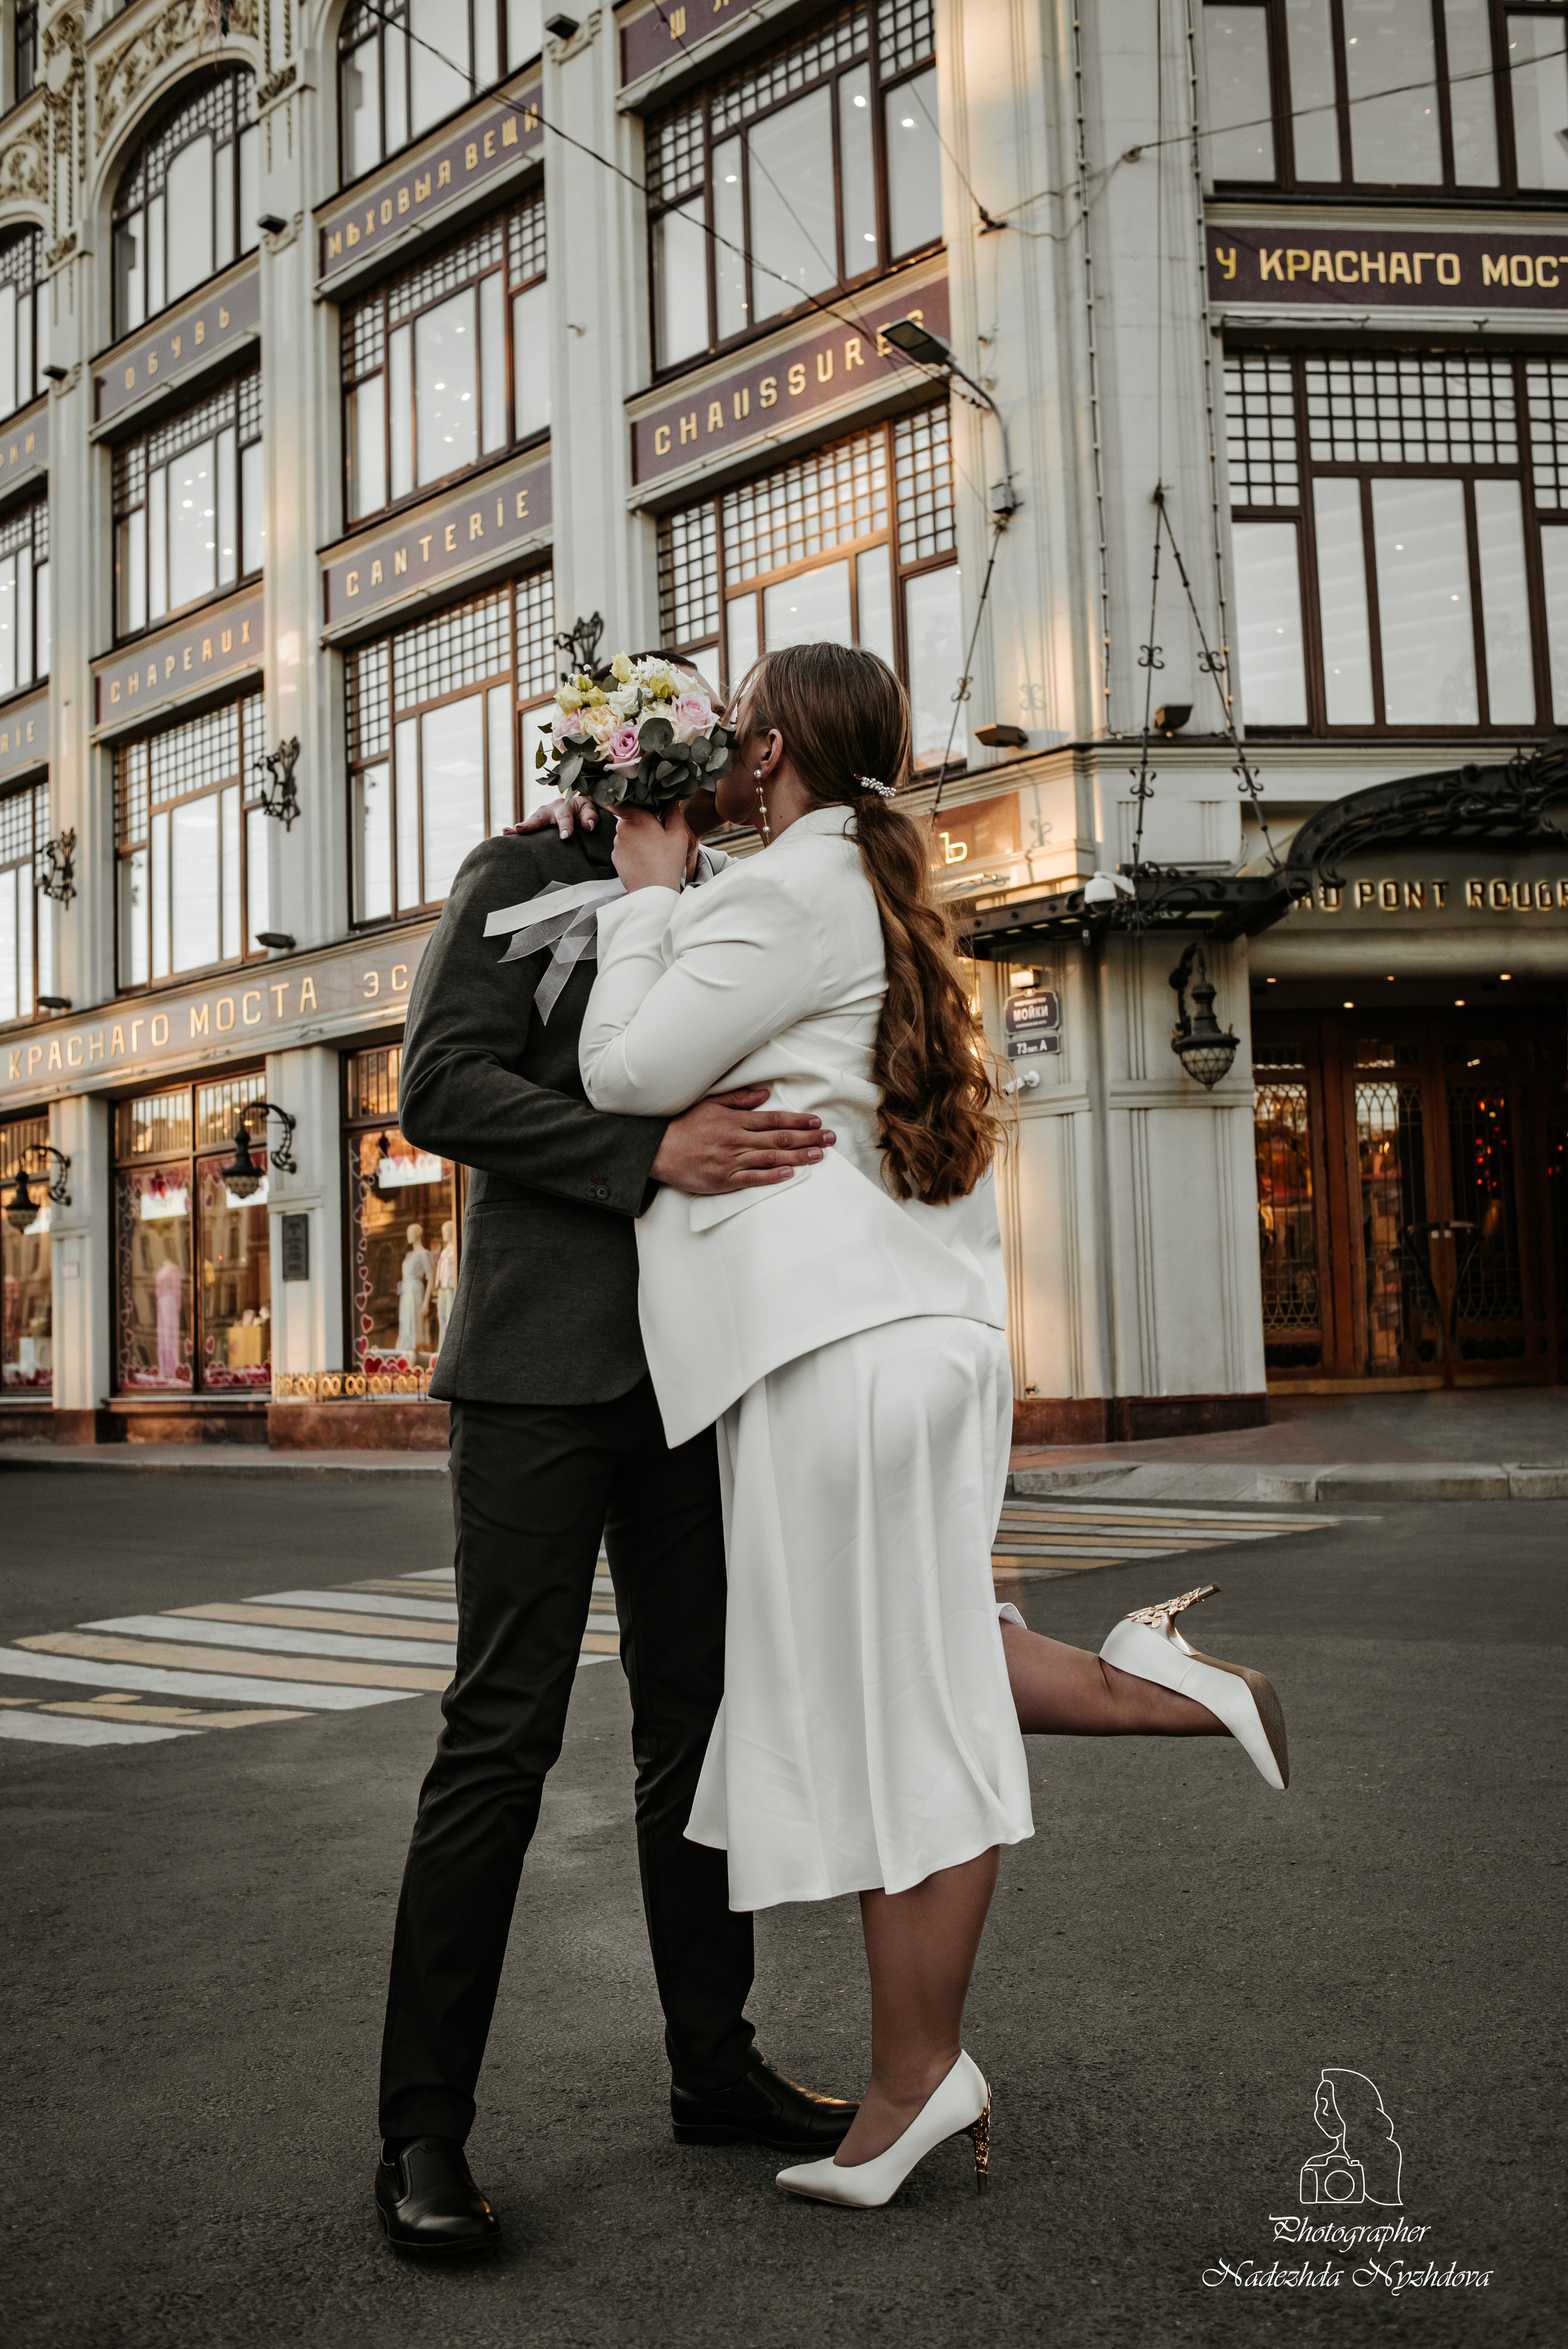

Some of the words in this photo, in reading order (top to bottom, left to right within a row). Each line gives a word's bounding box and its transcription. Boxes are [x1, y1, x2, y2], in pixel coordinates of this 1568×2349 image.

[466, 103, 538, 171] ВЕЩИ
[1215, 247, 1236, 280] У
[1259, 248, 1461, 286] КРАСНАГО
[111, 619, 250, 704] CHAPEAUX
[1354, 878, 1450, 911] PONT
[9, 1014, 169, 1081] КРАСНАГО
[190, 976, 318, 1039] МОСТА
[1013, 1004, 1049, 1021] МОЙКИ
[1017, 1042, 1027, 1054] 73
